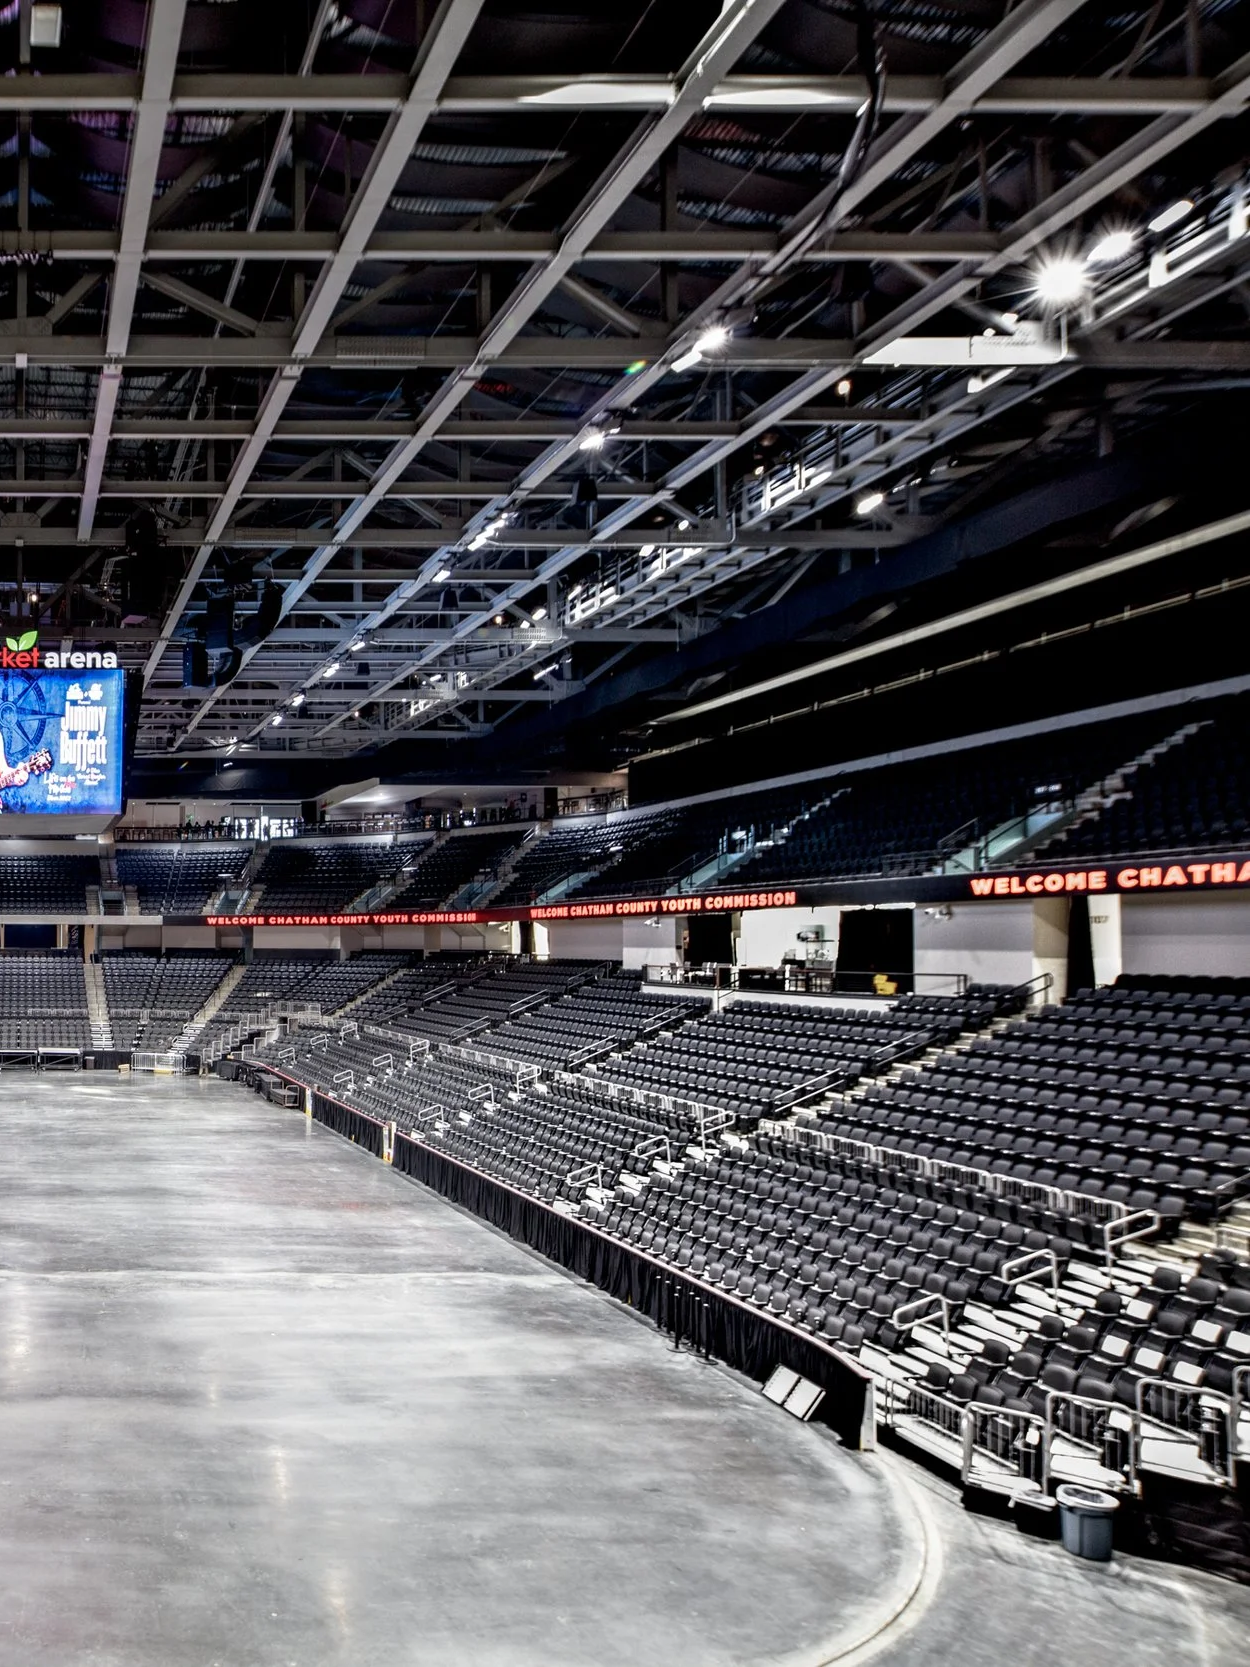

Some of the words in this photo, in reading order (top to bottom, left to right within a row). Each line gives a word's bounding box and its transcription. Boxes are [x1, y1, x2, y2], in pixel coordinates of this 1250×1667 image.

[44, 651, 118, 669] arena
[61, 701, 107, 736] Jimmy
[60, 731, 107, 772] Buffett
[970, 870, 1107, 896] WELCOME
[207, 916, 265, 925] WELCOME
[268, 916, 328, 925] CHATHAM
[330, 915, 369, 925] COUNTY
[372, 914, 409, 924] YOUTH
[412, 912, 477, 923] COMMISSION
[530, 906, 568, 919] WELCOME
[570, 903, 614, 917] CHATHAM
[616, 900, 658, 914] COUNTY
[661, 897, 702, 912] YOUTH
[704, 891, 796, 910] COMMISSION
